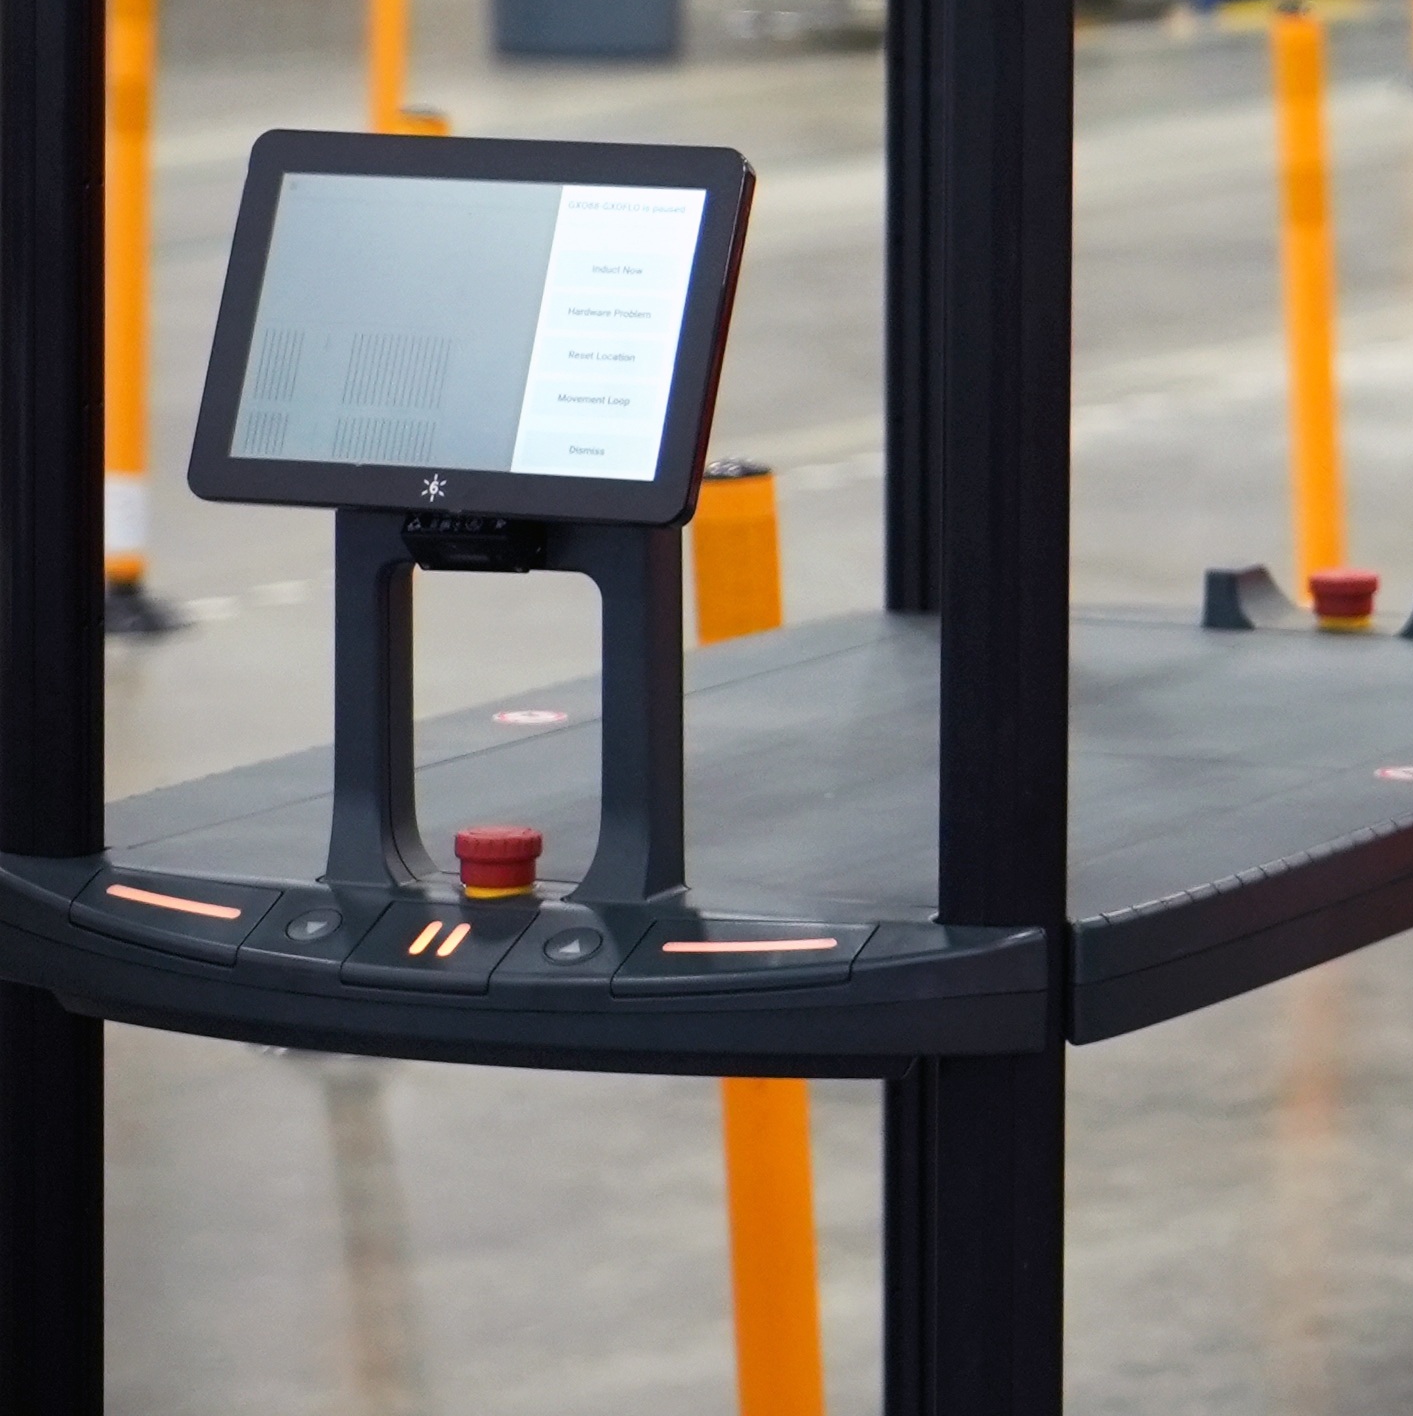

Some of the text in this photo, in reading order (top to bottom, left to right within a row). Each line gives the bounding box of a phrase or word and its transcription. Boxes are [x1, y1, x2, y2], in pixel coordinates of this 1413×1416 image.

[652, 204, 686, 215] paused
[592, 264, 644, 275] Induct Now
[568, 306, 652, 319] Hardware Problem
[568, 350, 636, 363] Reset Location
[557, 393, 631, 407] Movement Loop
[569, 445, 605, 456] Dismiss
[429, 480, 439, 495] 6
